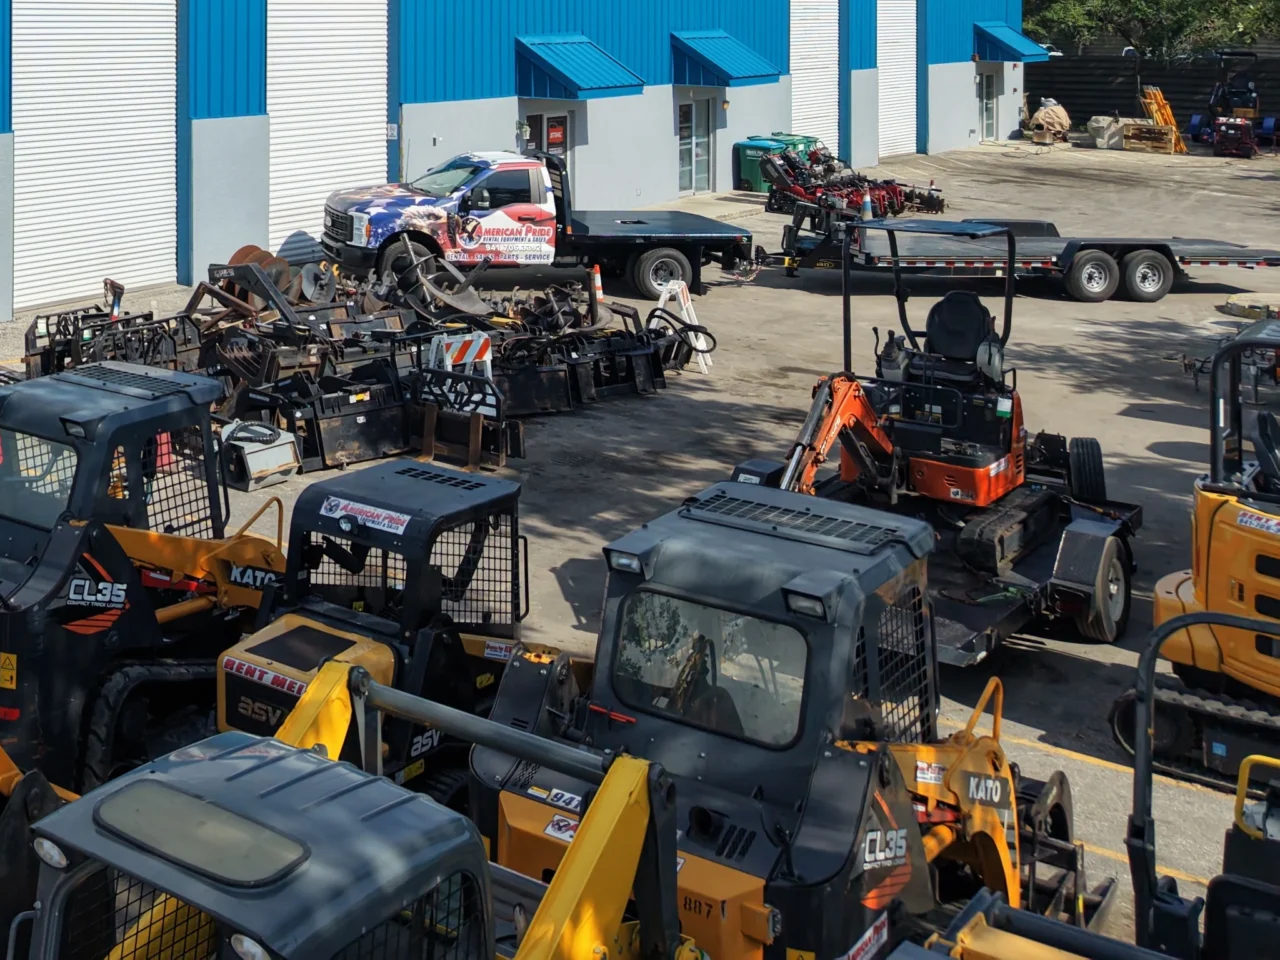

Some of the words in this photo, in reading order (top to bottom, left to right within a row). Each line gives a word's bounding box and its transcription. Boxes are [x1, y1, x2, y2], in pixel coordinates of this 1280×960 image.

[475, 224, 522, 237] AMERICAN
[525, 225, 552, 236] PRIDE
[69, 578, 127, 601] CL35
[224, 658, 268, 681] RENT
[969, 776, 1001, 803] KATO
[865, 829, 907, 862] CL35
